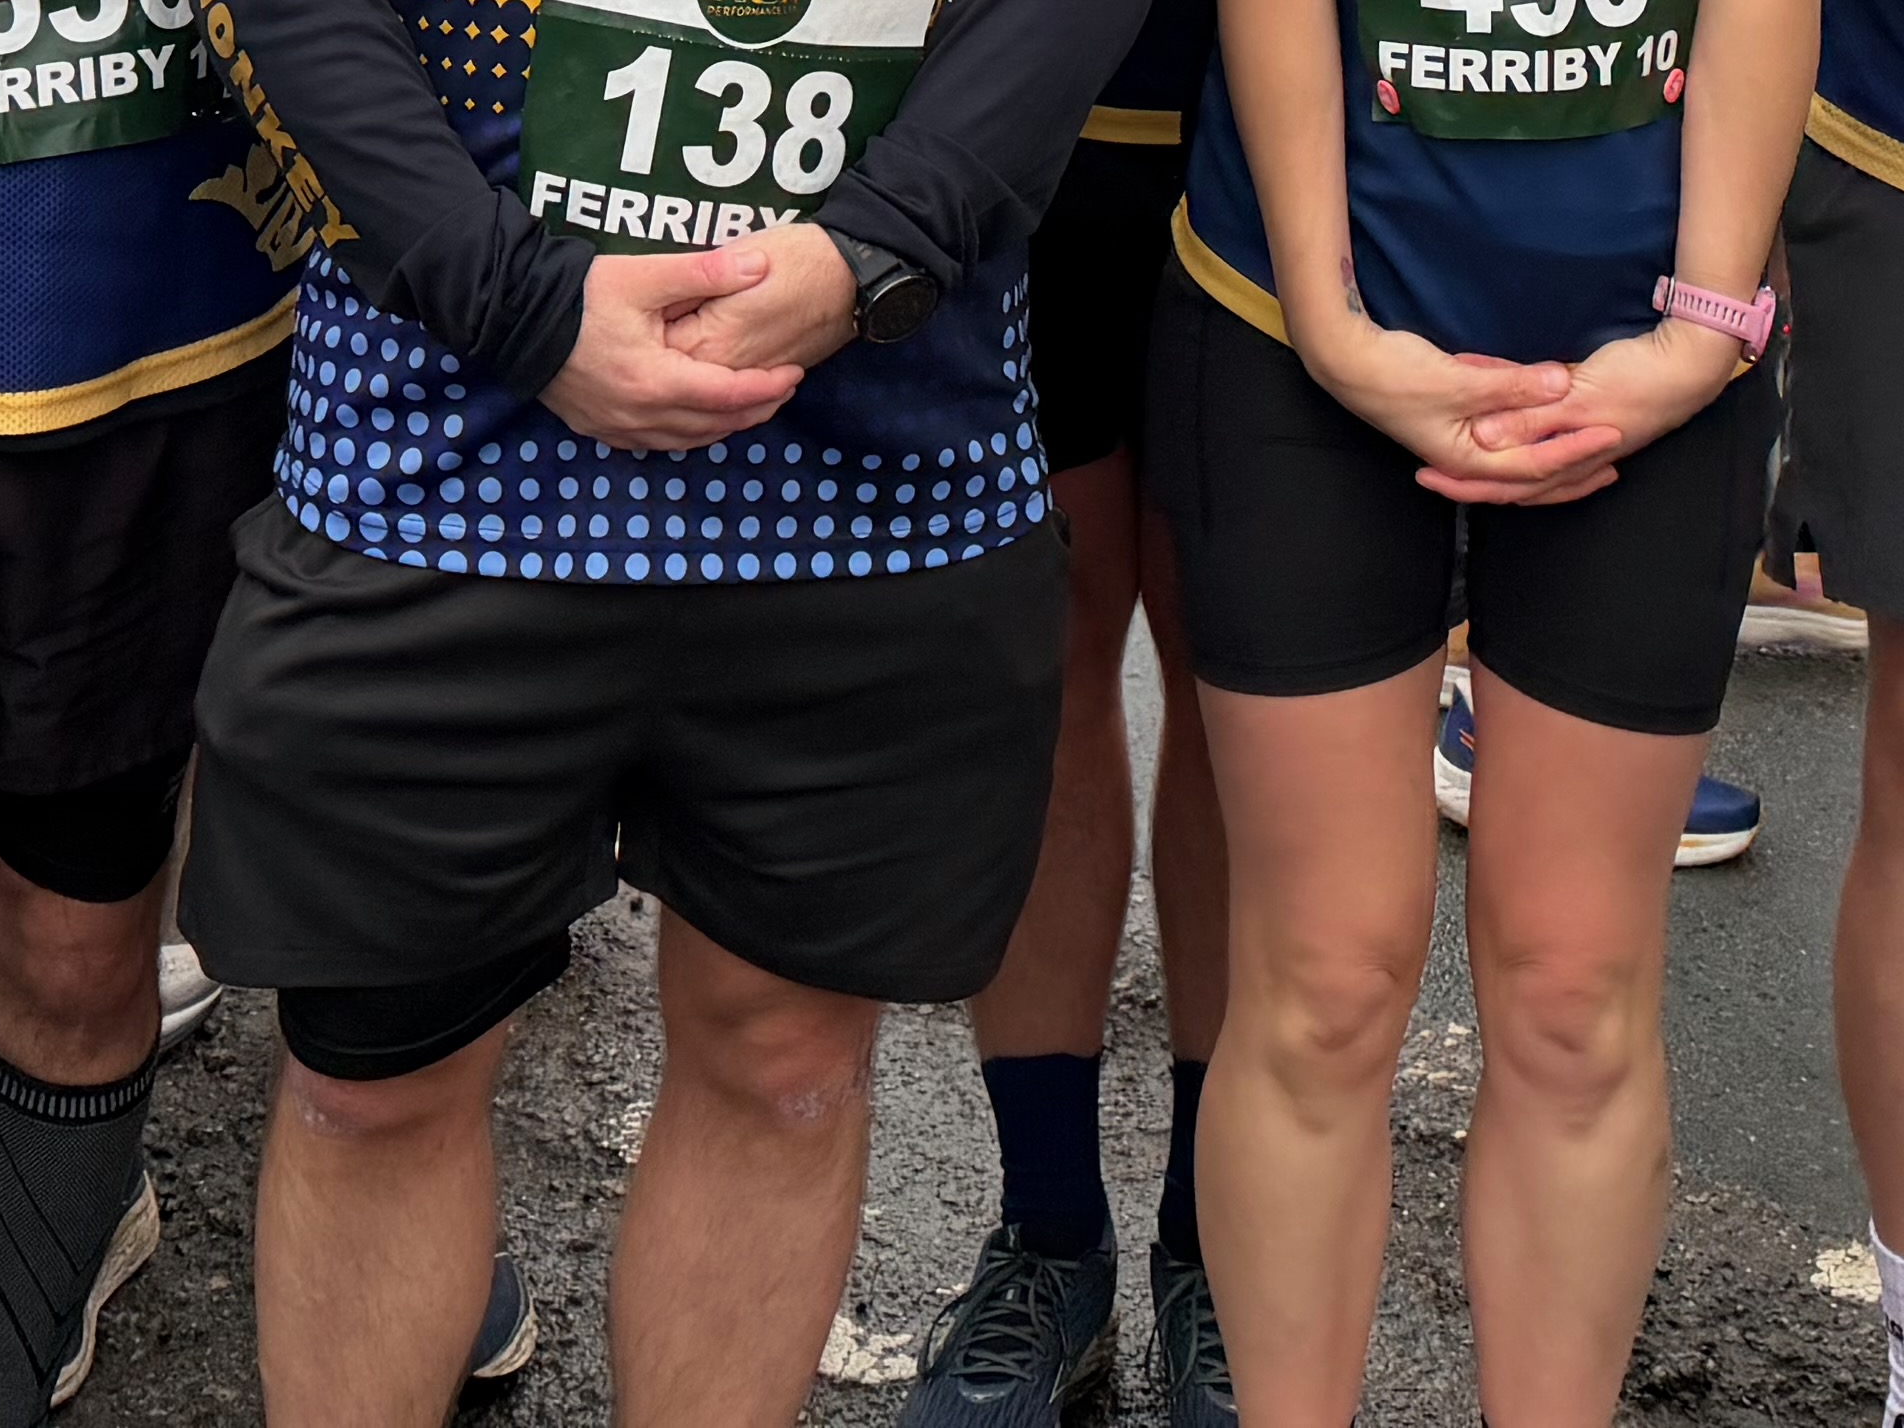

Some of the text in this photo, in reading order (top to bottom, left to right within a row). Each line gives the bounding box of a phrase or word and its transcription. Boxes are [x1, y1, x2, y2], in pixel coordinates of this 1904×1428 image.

[1379, 29, 1678, 93] FERRIBY 10
[603, 45, 852, 195] 138
